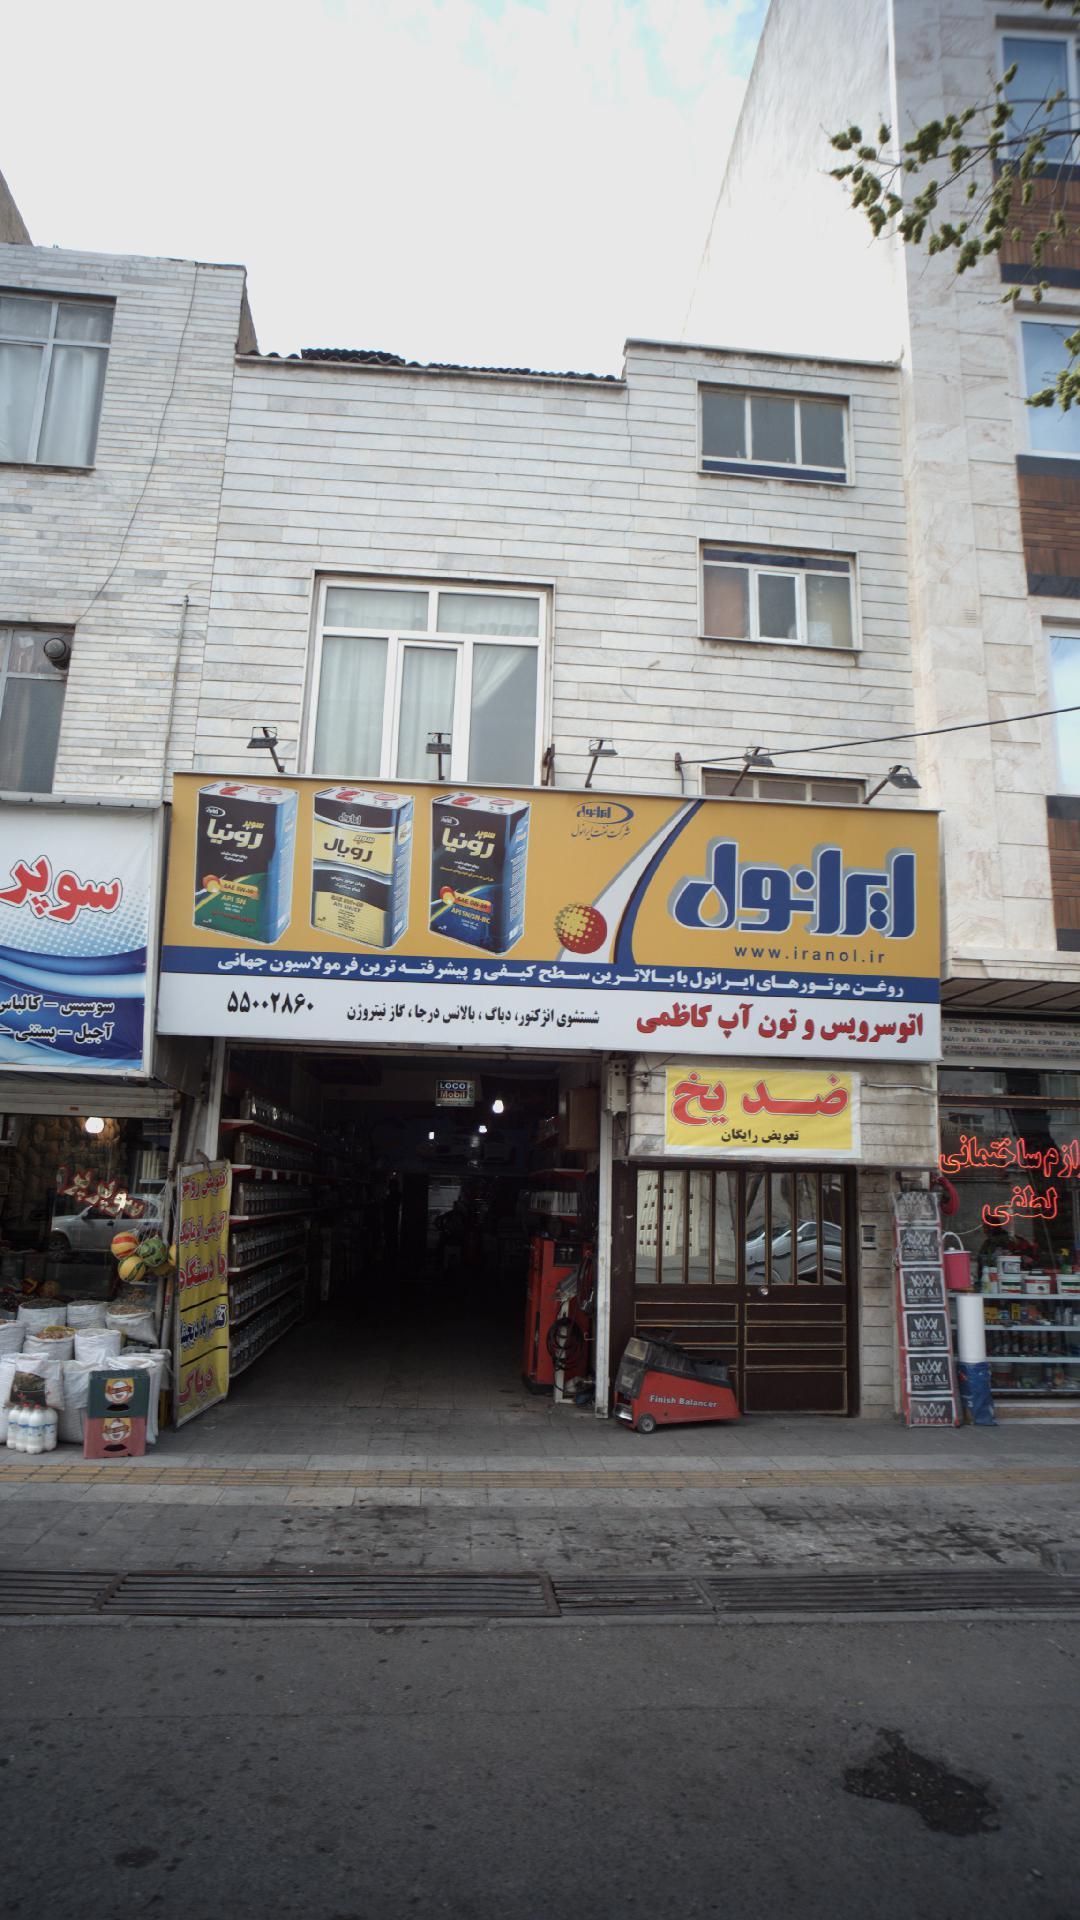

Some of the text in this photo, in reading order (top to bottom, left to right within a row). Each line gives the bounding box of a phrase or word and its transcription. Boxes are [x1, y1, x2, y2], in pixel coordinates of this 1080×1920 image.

[207, 818, 264, 850] رونیا
[242, 819, 265, 831] سوپر
[441, 827, 495, 859] رونیا
[475, 830, 496, 841] سوپر
[323, 837, 374, 863] رویال
[0, 856, 121, 923] سوپر
[667, 837, 916, 939] ایرانول
[217, 952, 268, 971] جهانی
[734, 945, 885, 963] www.iranol.ir
[269, 955, 359, 976] فرمولاسیون
[359, 958, 397, 977] ترین
[398, 959, 468, 981] پیشرفته
[472, 966, 482, 981] و
[483, 963, 537, 981] کیفی
[538, 965, 591, 983] سطح
[592, 968, 674, 988] بالاترین
[676, 969, 689, 988] با
[689, 971, 755, 991] ایرانول
[852, 979, 904, 998] روغن
[60, 1000, 114, 1017] سوسیس
[227, 990, 314, 1014] ۵۵۰۰۲۸۶۰
[388, 1002, 406, 1021] گاز
[346, 1002, 387, 1022] نیتروژن
[442, 1004, 476, 1024] بالانس
[556, 1009, 600, 1028] شستشوی
[636, 1001, 924, 1043] اتوسرویس و تون آپ کاظمی
[14, 1023, 57, 1043] بستنی
[74, 1022, 114, 1044] آجیل
[440, 1090, 466, 1098] Mobil
[672, 1071, 849, 1126] ضد یخ
[721, 1128, 799, 1145] تعویض رایگان
[938, 1134, 1042, 1174] ساختمانی
[982, 1184, 1058, 1227] لطفی
[911, 1330, 945, 1339] ROYAL
[913, 1374, 948, 1383] ROYAL
[649, 1394, 719, 1409] Finish Balancer
